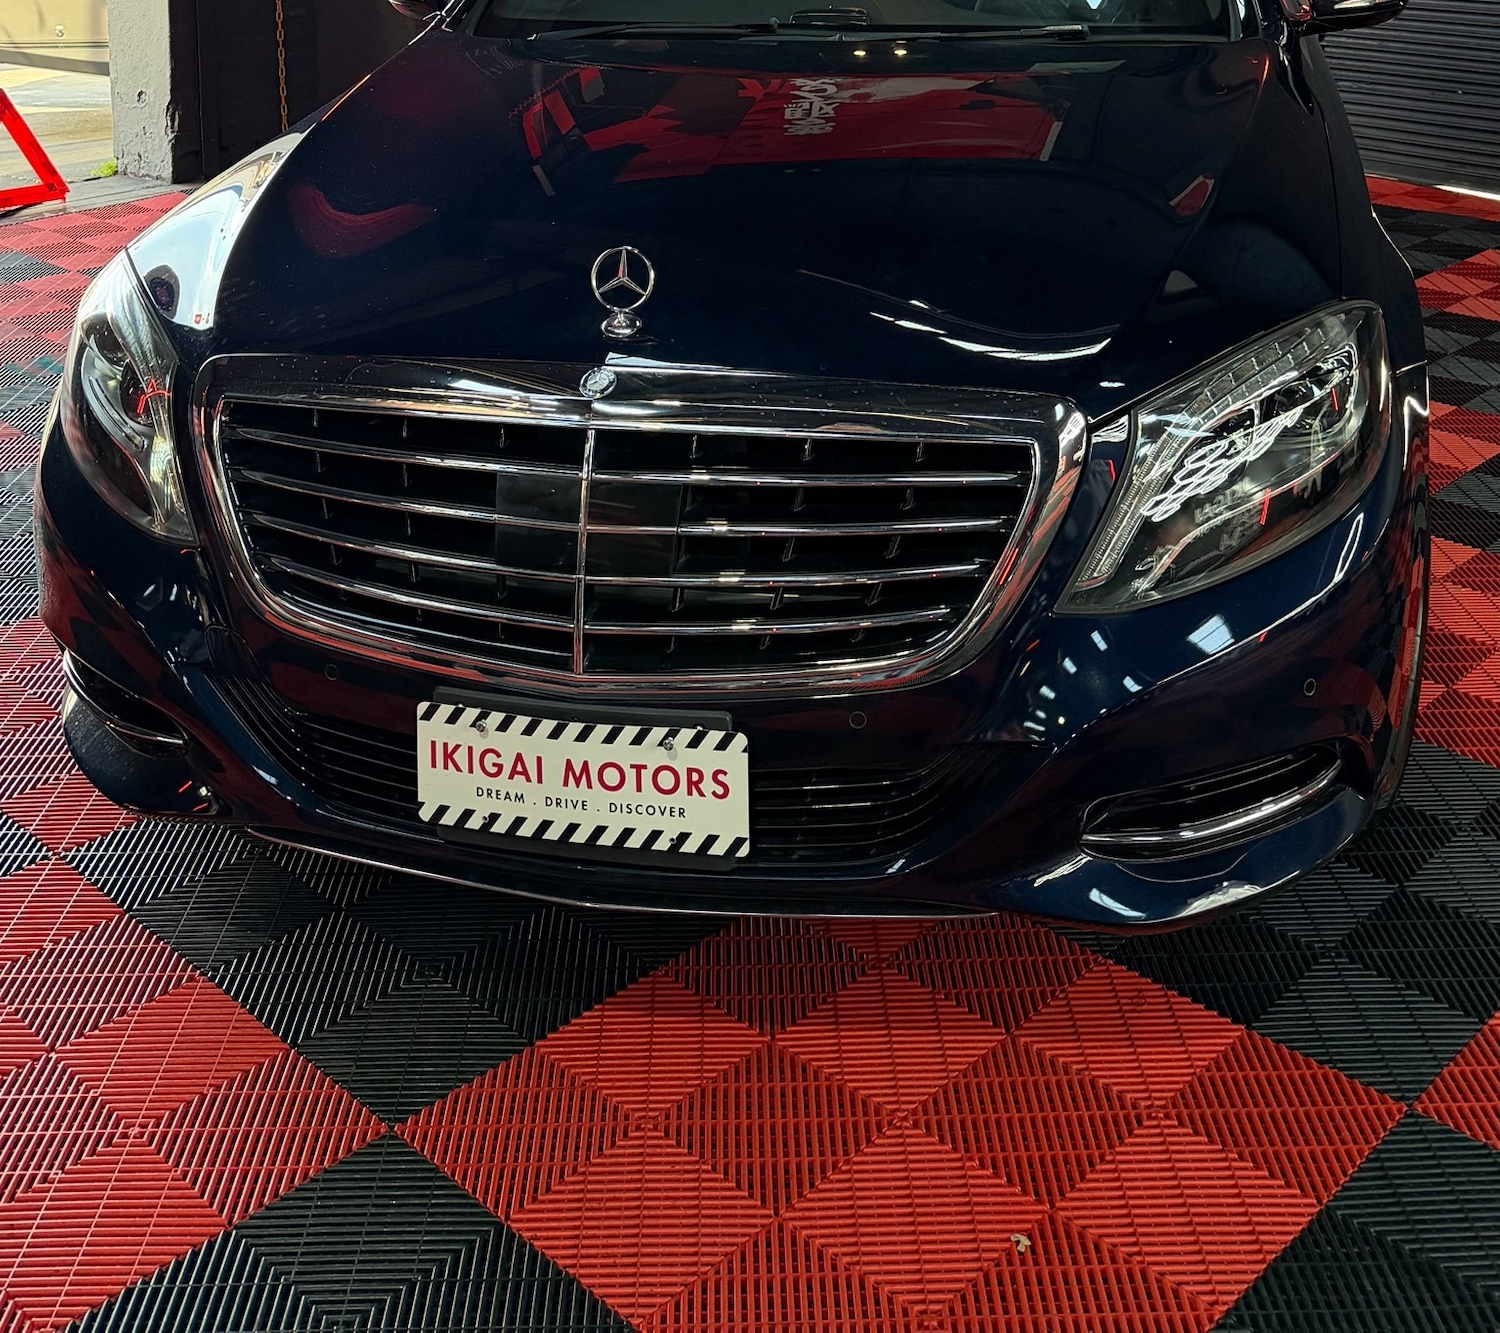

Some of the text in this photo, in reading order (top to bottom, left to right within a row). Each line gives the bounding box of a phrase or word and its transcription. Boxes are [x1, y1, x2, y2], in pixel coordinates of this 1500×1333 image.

[430, 740, 731, 801] IKIGAI MOTORS
[476, 786, 525, 805] DREAM
[545, 796, 588, 812] DRIVE
[609, 802, 687, 819] DISCOVER
